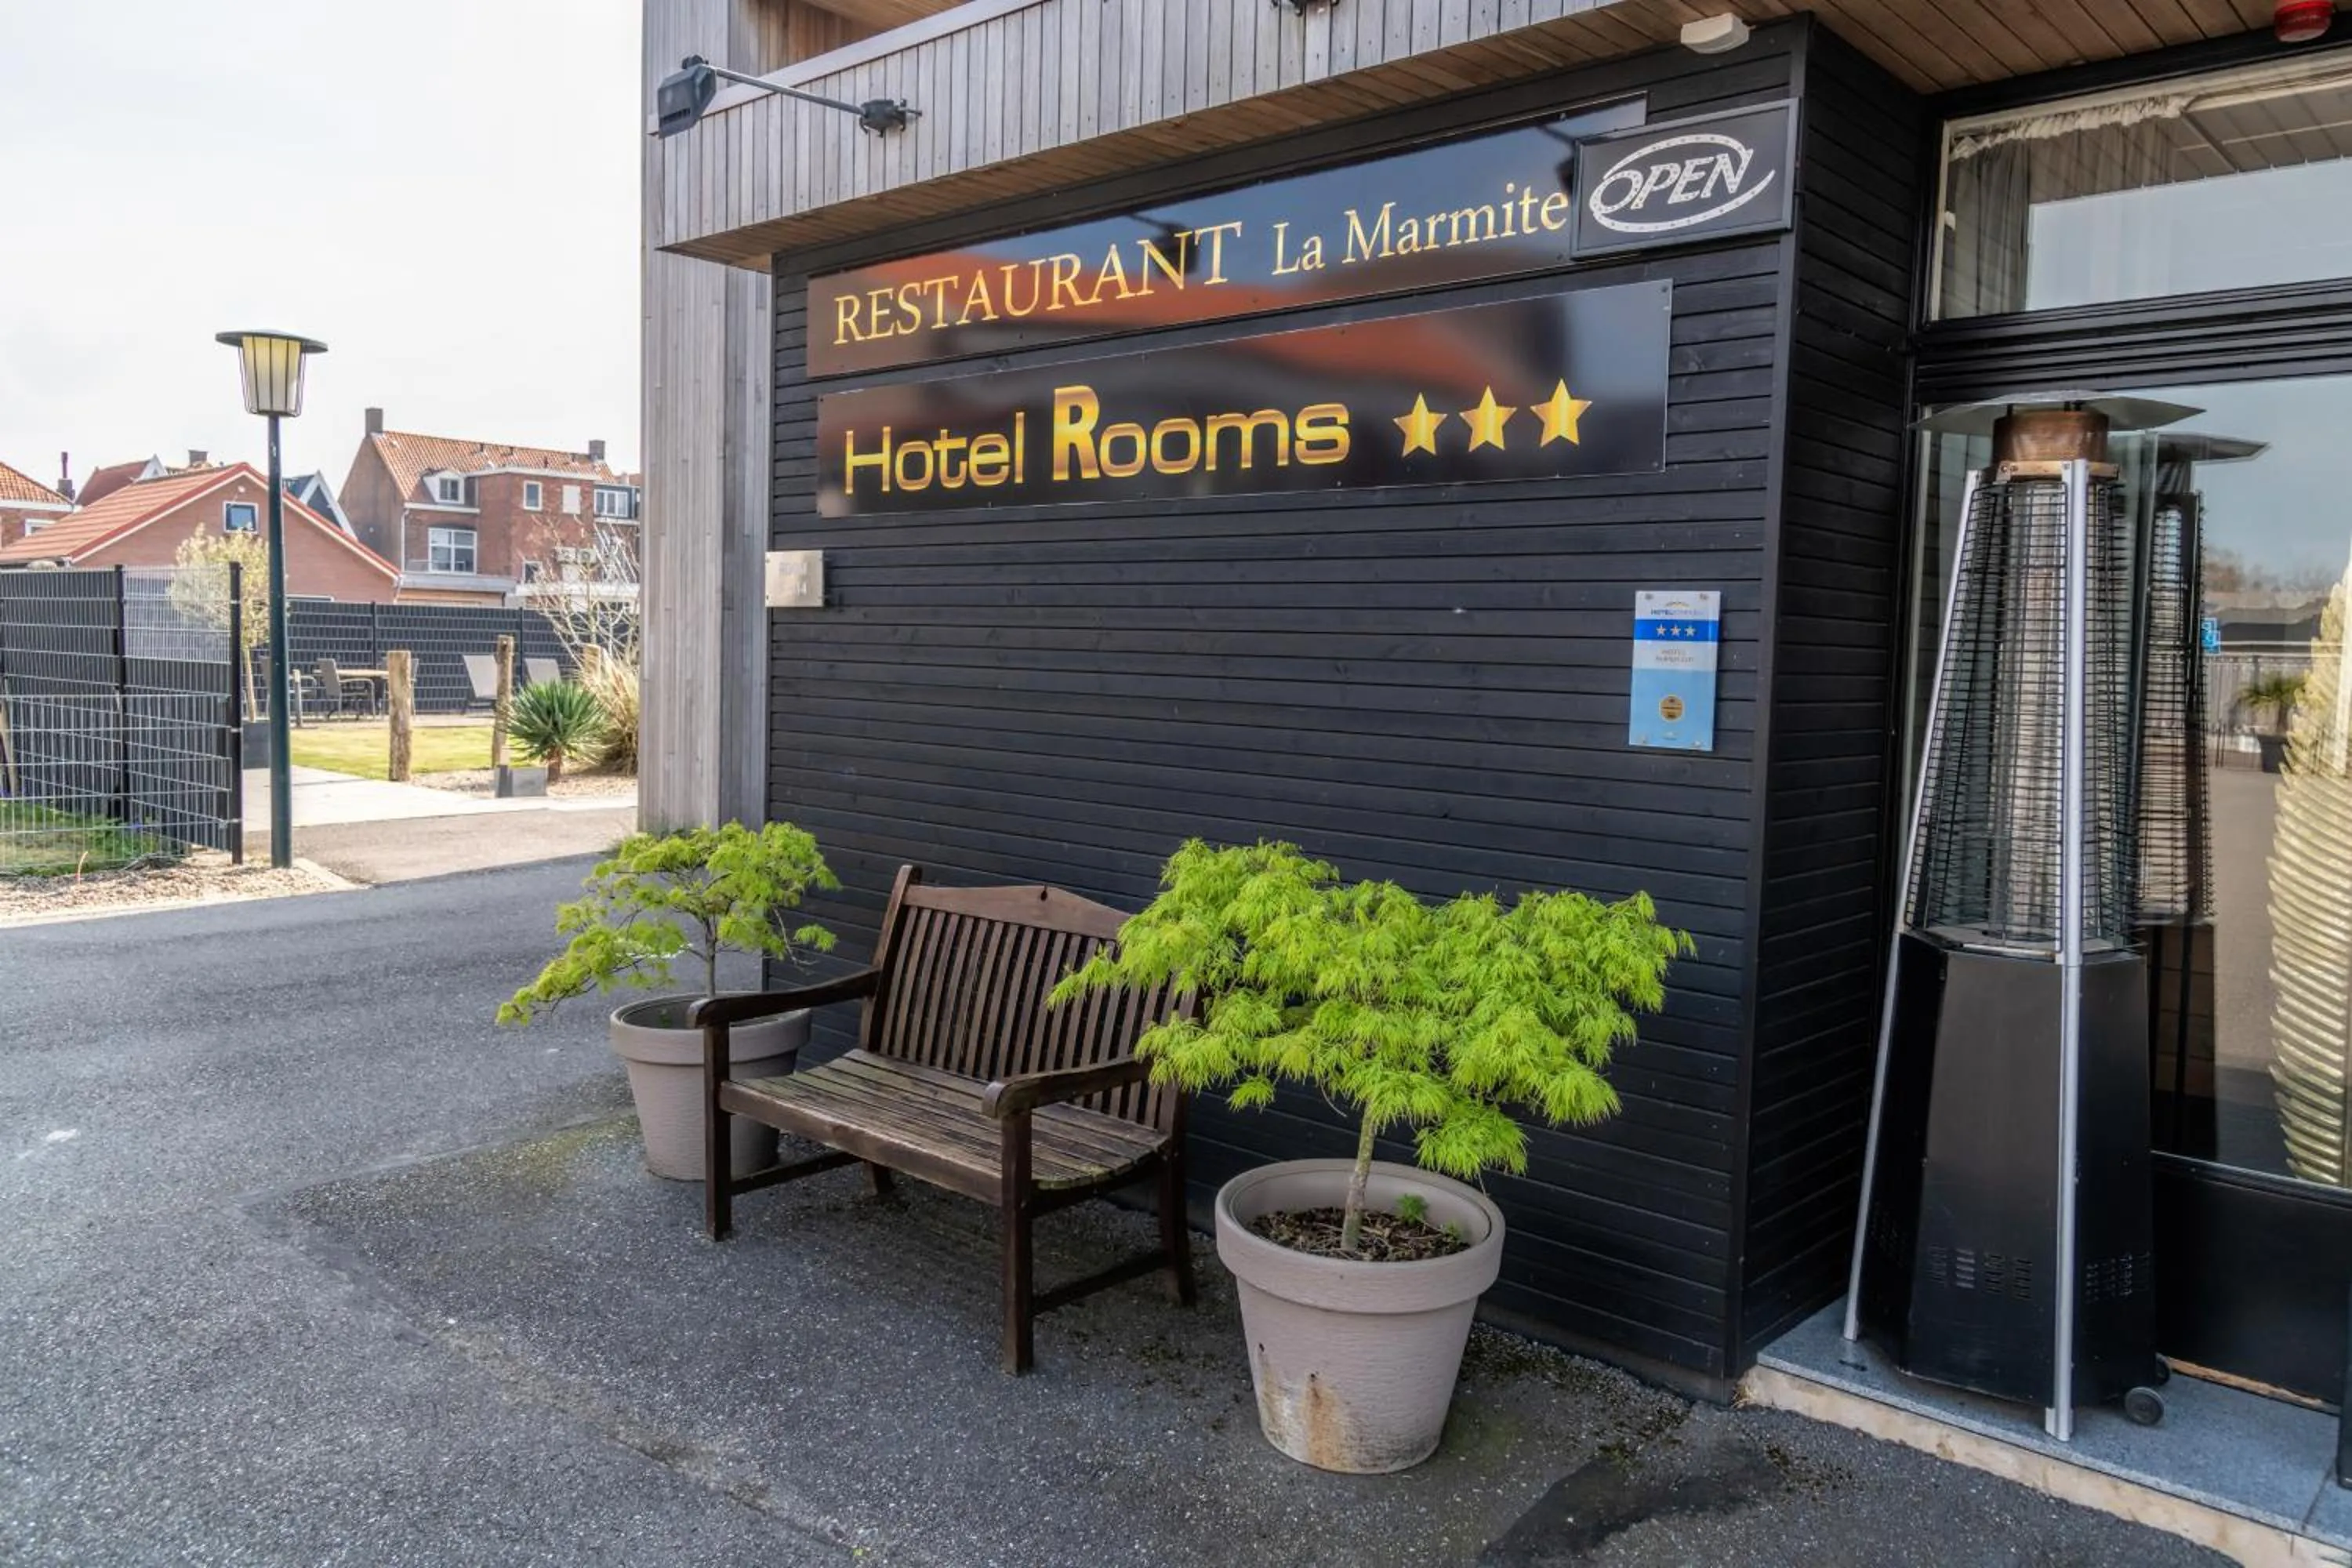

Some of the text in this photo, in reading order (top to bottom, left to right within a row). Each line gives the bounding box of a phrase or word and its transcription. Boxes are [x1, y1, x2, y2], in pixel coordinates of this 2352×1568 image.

[1589, 149, 1755, 214] OPEN
[833, 183, 1569, 345] RESTAURANT La Marmite
[845, 385, 1350, 495] Hotel Rooms
